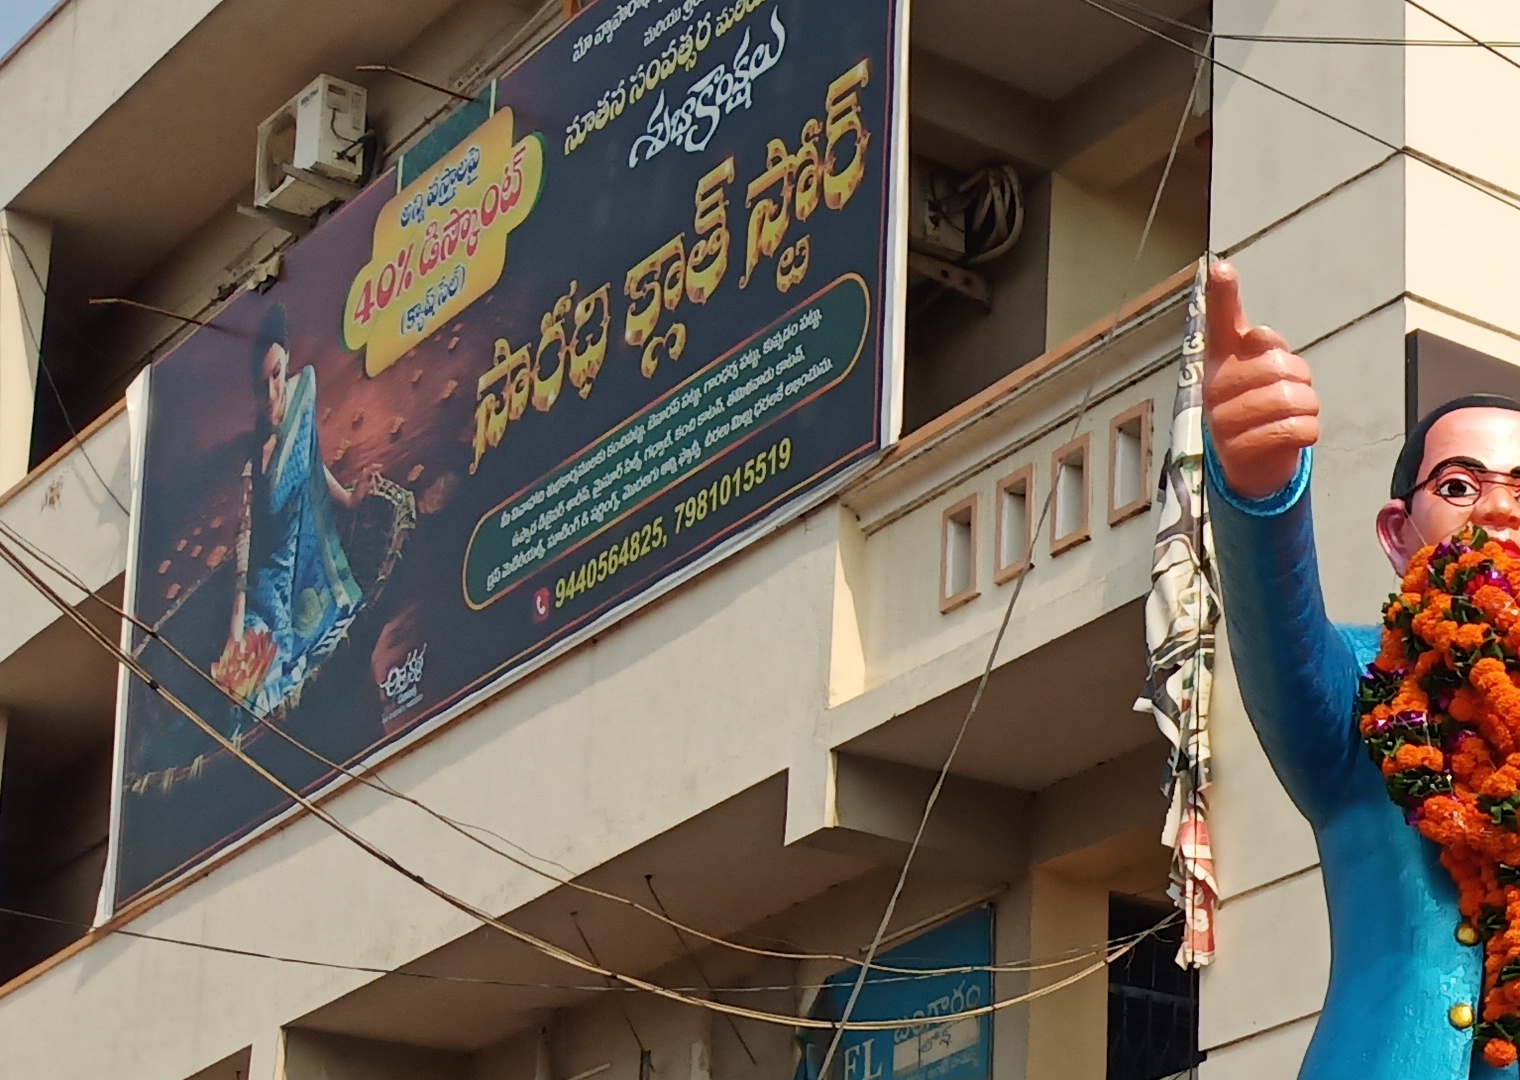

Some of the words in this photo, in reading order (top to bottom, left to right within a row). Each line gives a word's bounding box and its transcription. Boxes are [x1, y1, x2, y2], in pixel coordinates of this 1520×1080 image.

[564, 80, 625, 155] నూతన
[630, 17, 711, 104] సంవత్సర
[573, 37, 592, 62] మా
[628, 4, 786, 169] శుభాకాంక్షలు
[643, 8, 682, 46] మరియు
[354, 243, 414, 325] 40%
[624, 156, 736, 379] క్లాత్
[738, 57, 871, 293] స్టోర్
[555, 517, 667, 608] 9440564825,
[675, 437, 792, 534] 7981015519
